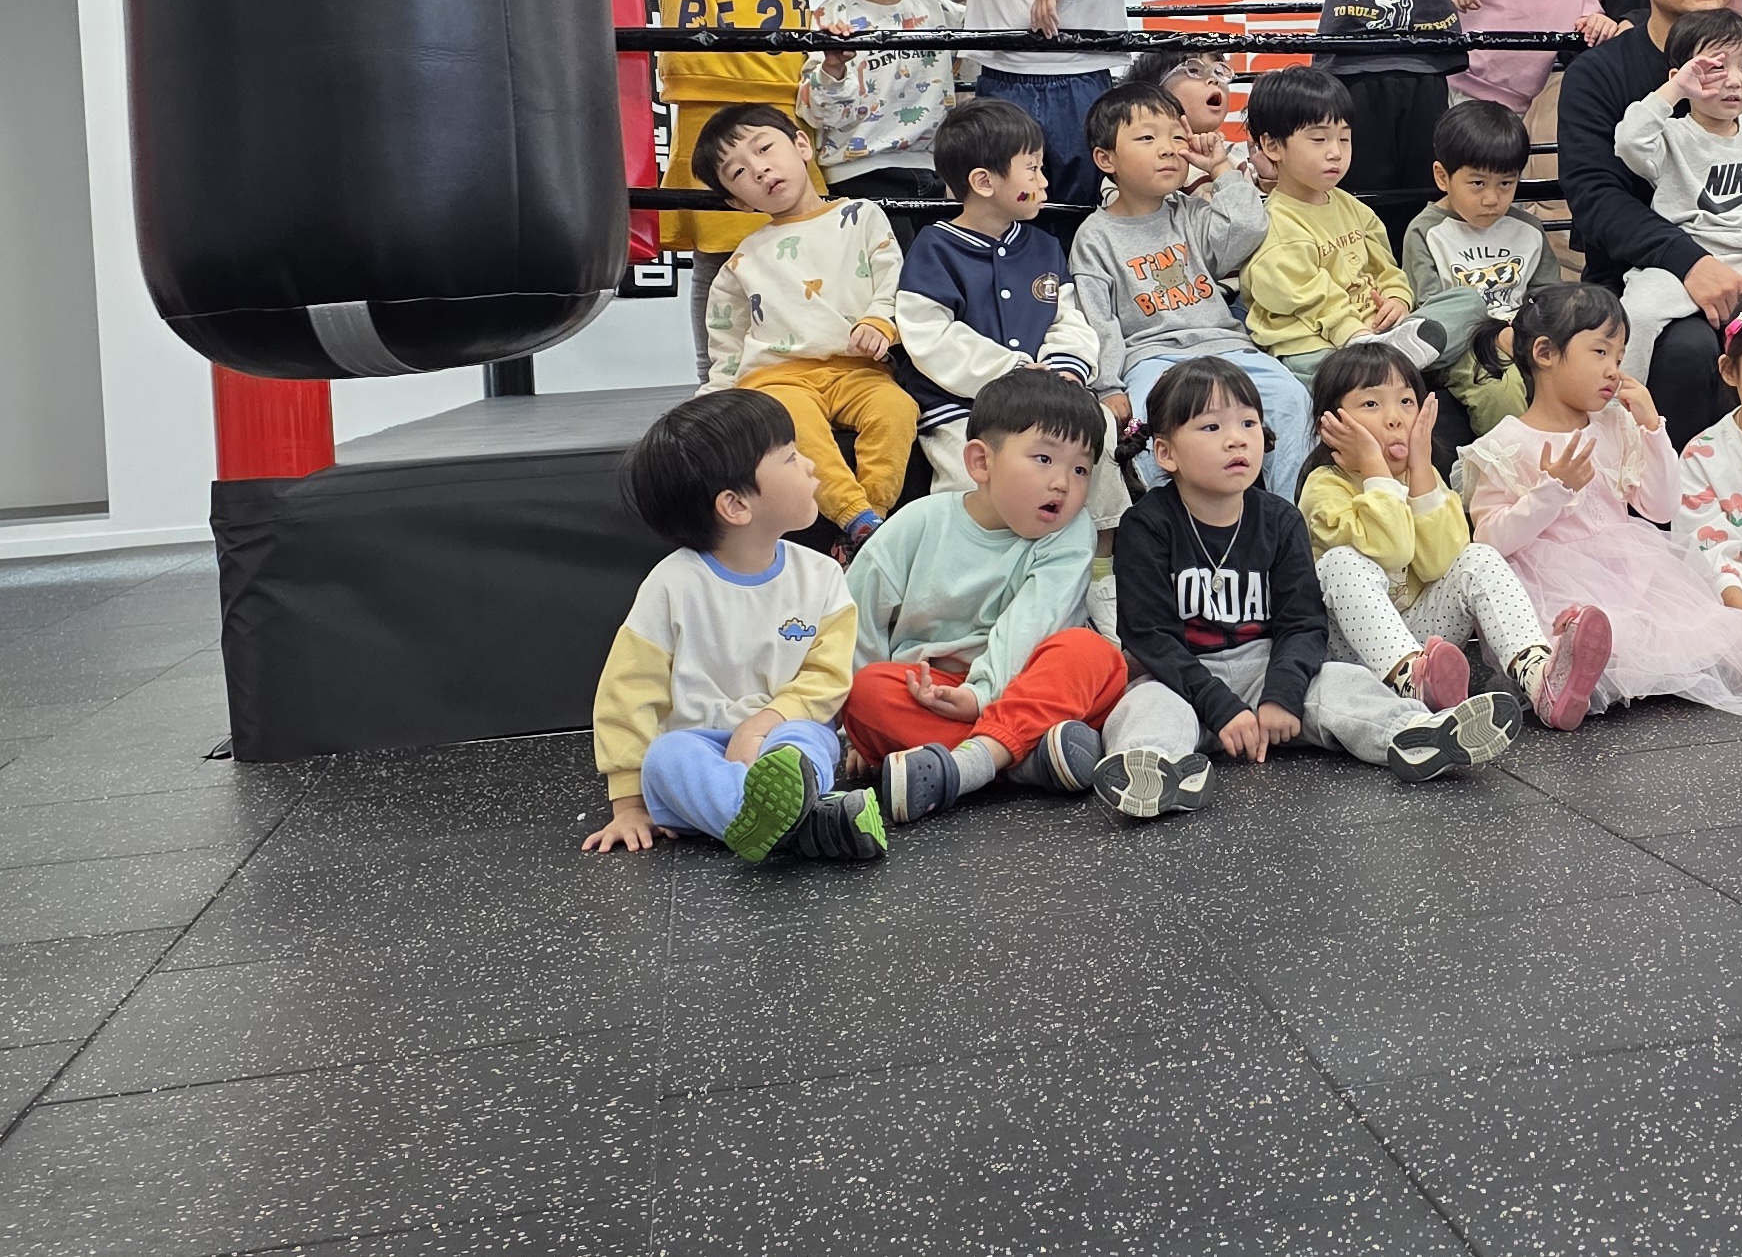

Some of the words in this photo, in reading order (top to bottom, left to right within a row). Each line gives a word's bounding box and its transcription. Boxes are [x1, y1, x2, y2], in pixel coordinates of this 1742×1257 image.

[1333, 5, 1345, 17] TO
[1347, 6, 1380, 19] RULE
[1458, 246, 1511, 262] WILD
[1170, 567, 1272, 624] ORDA
